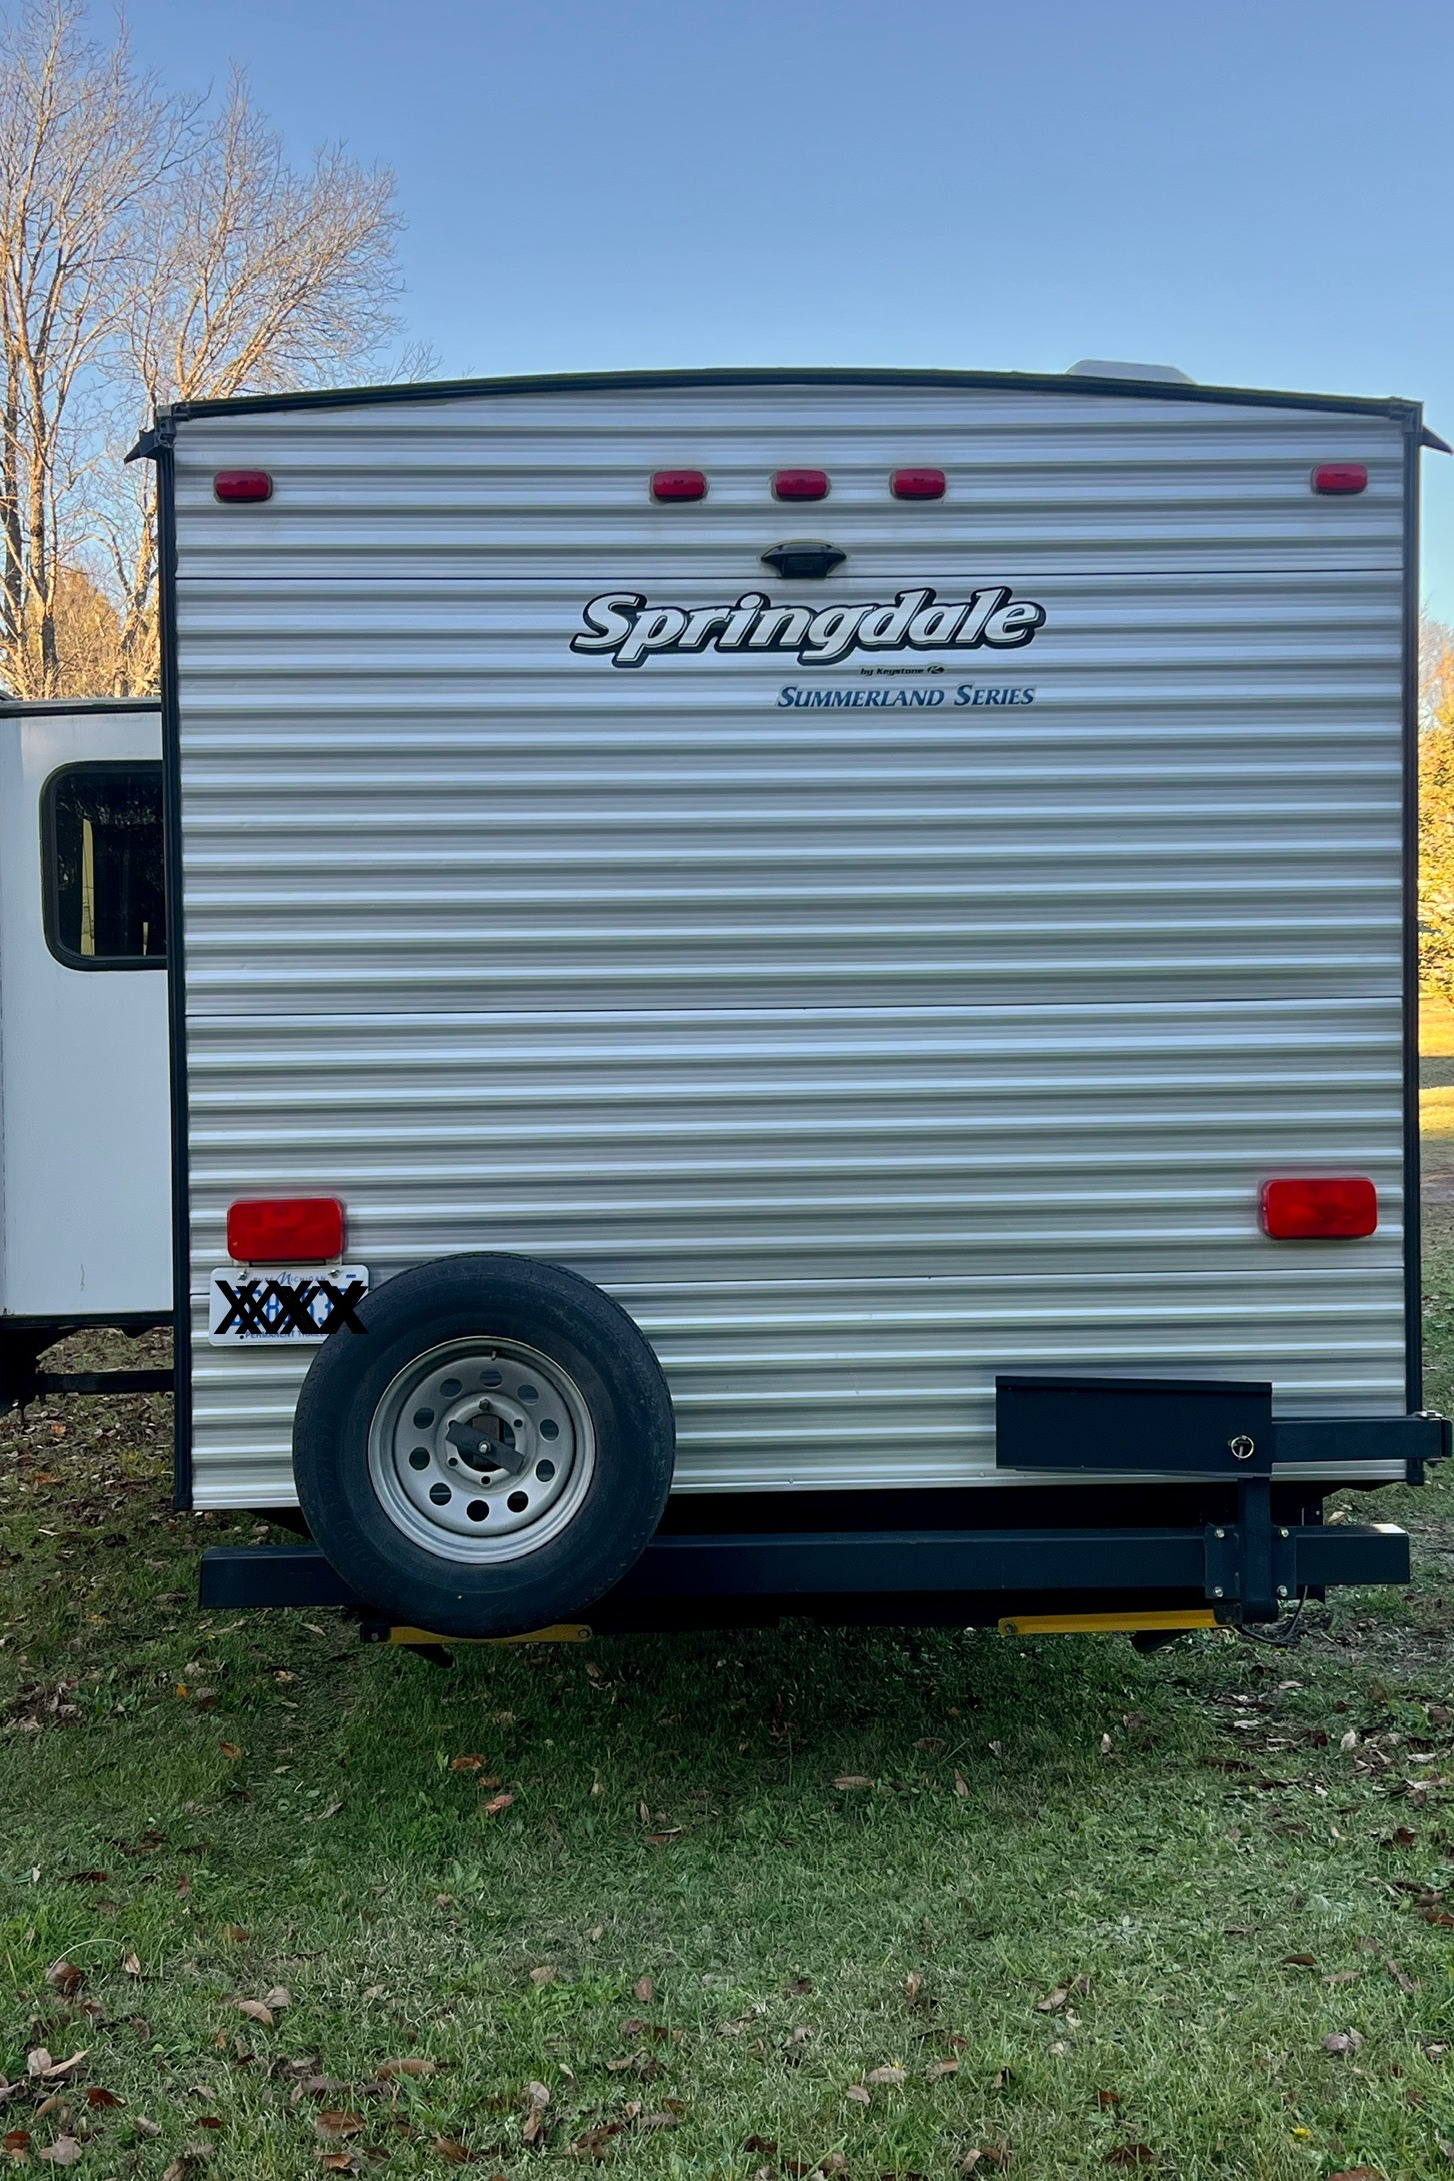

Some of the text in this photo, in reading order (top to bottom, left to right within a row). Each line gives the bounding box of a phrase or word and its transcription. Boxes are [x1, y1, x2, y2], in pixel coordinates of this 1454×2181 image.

[570, 586, 1046, 668] Springdale
[860, 668, 924, 676] by Keystone
[778, 685, 1034, 708] SUMMERLAND SERIES
